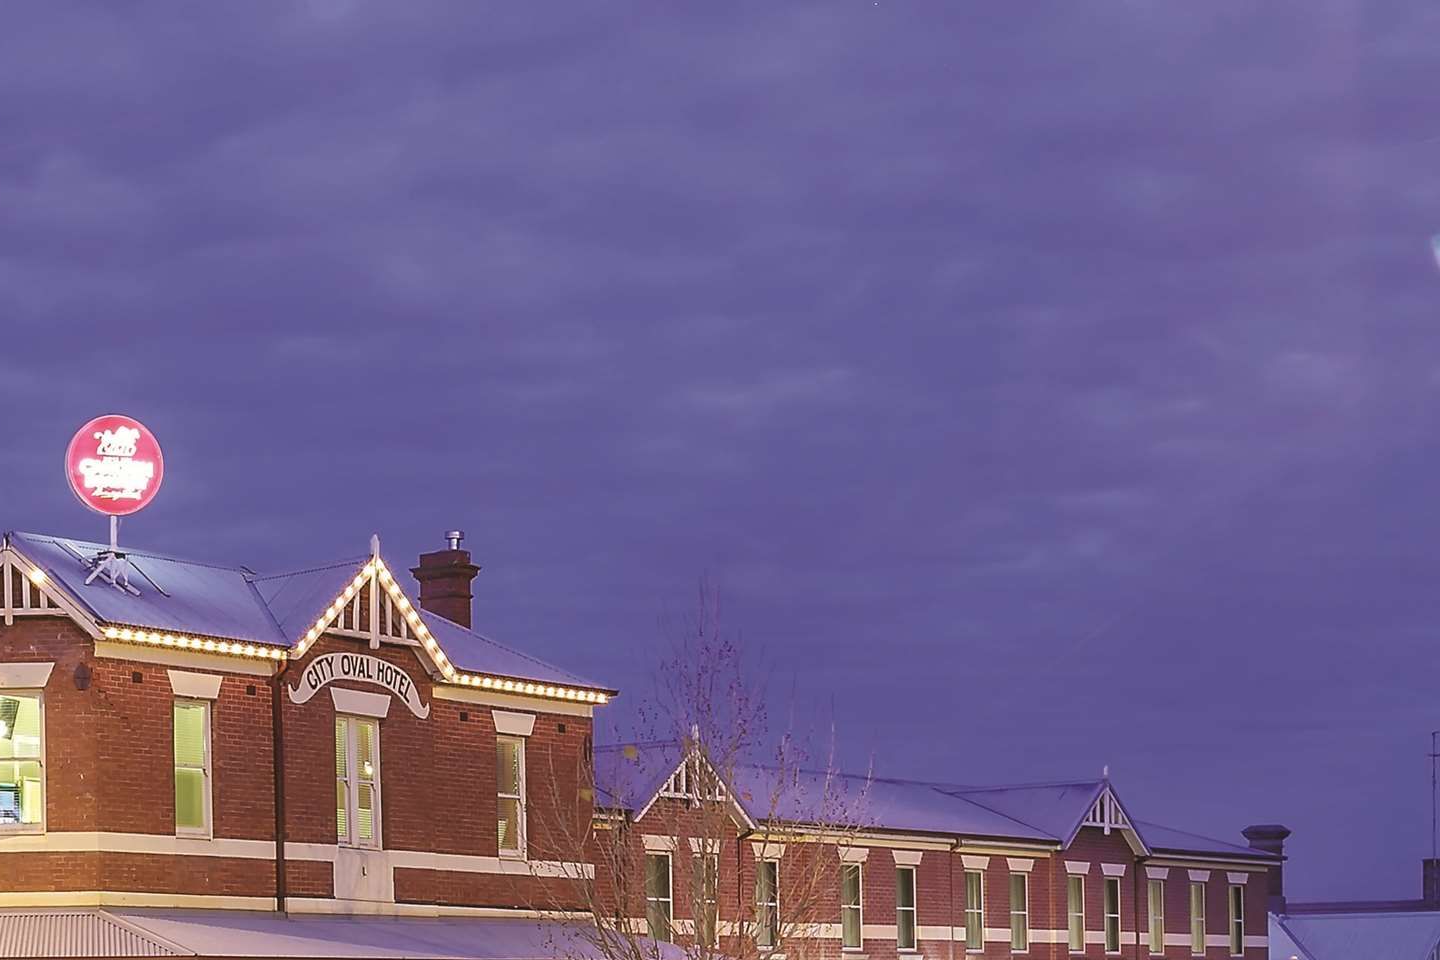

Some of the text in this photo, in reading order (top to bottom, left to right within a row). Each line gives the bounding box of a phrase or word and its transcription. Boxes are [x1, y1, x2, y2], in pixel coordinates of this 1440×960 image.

[307, 655, 413, 703] CITY OVAL HOTEL
